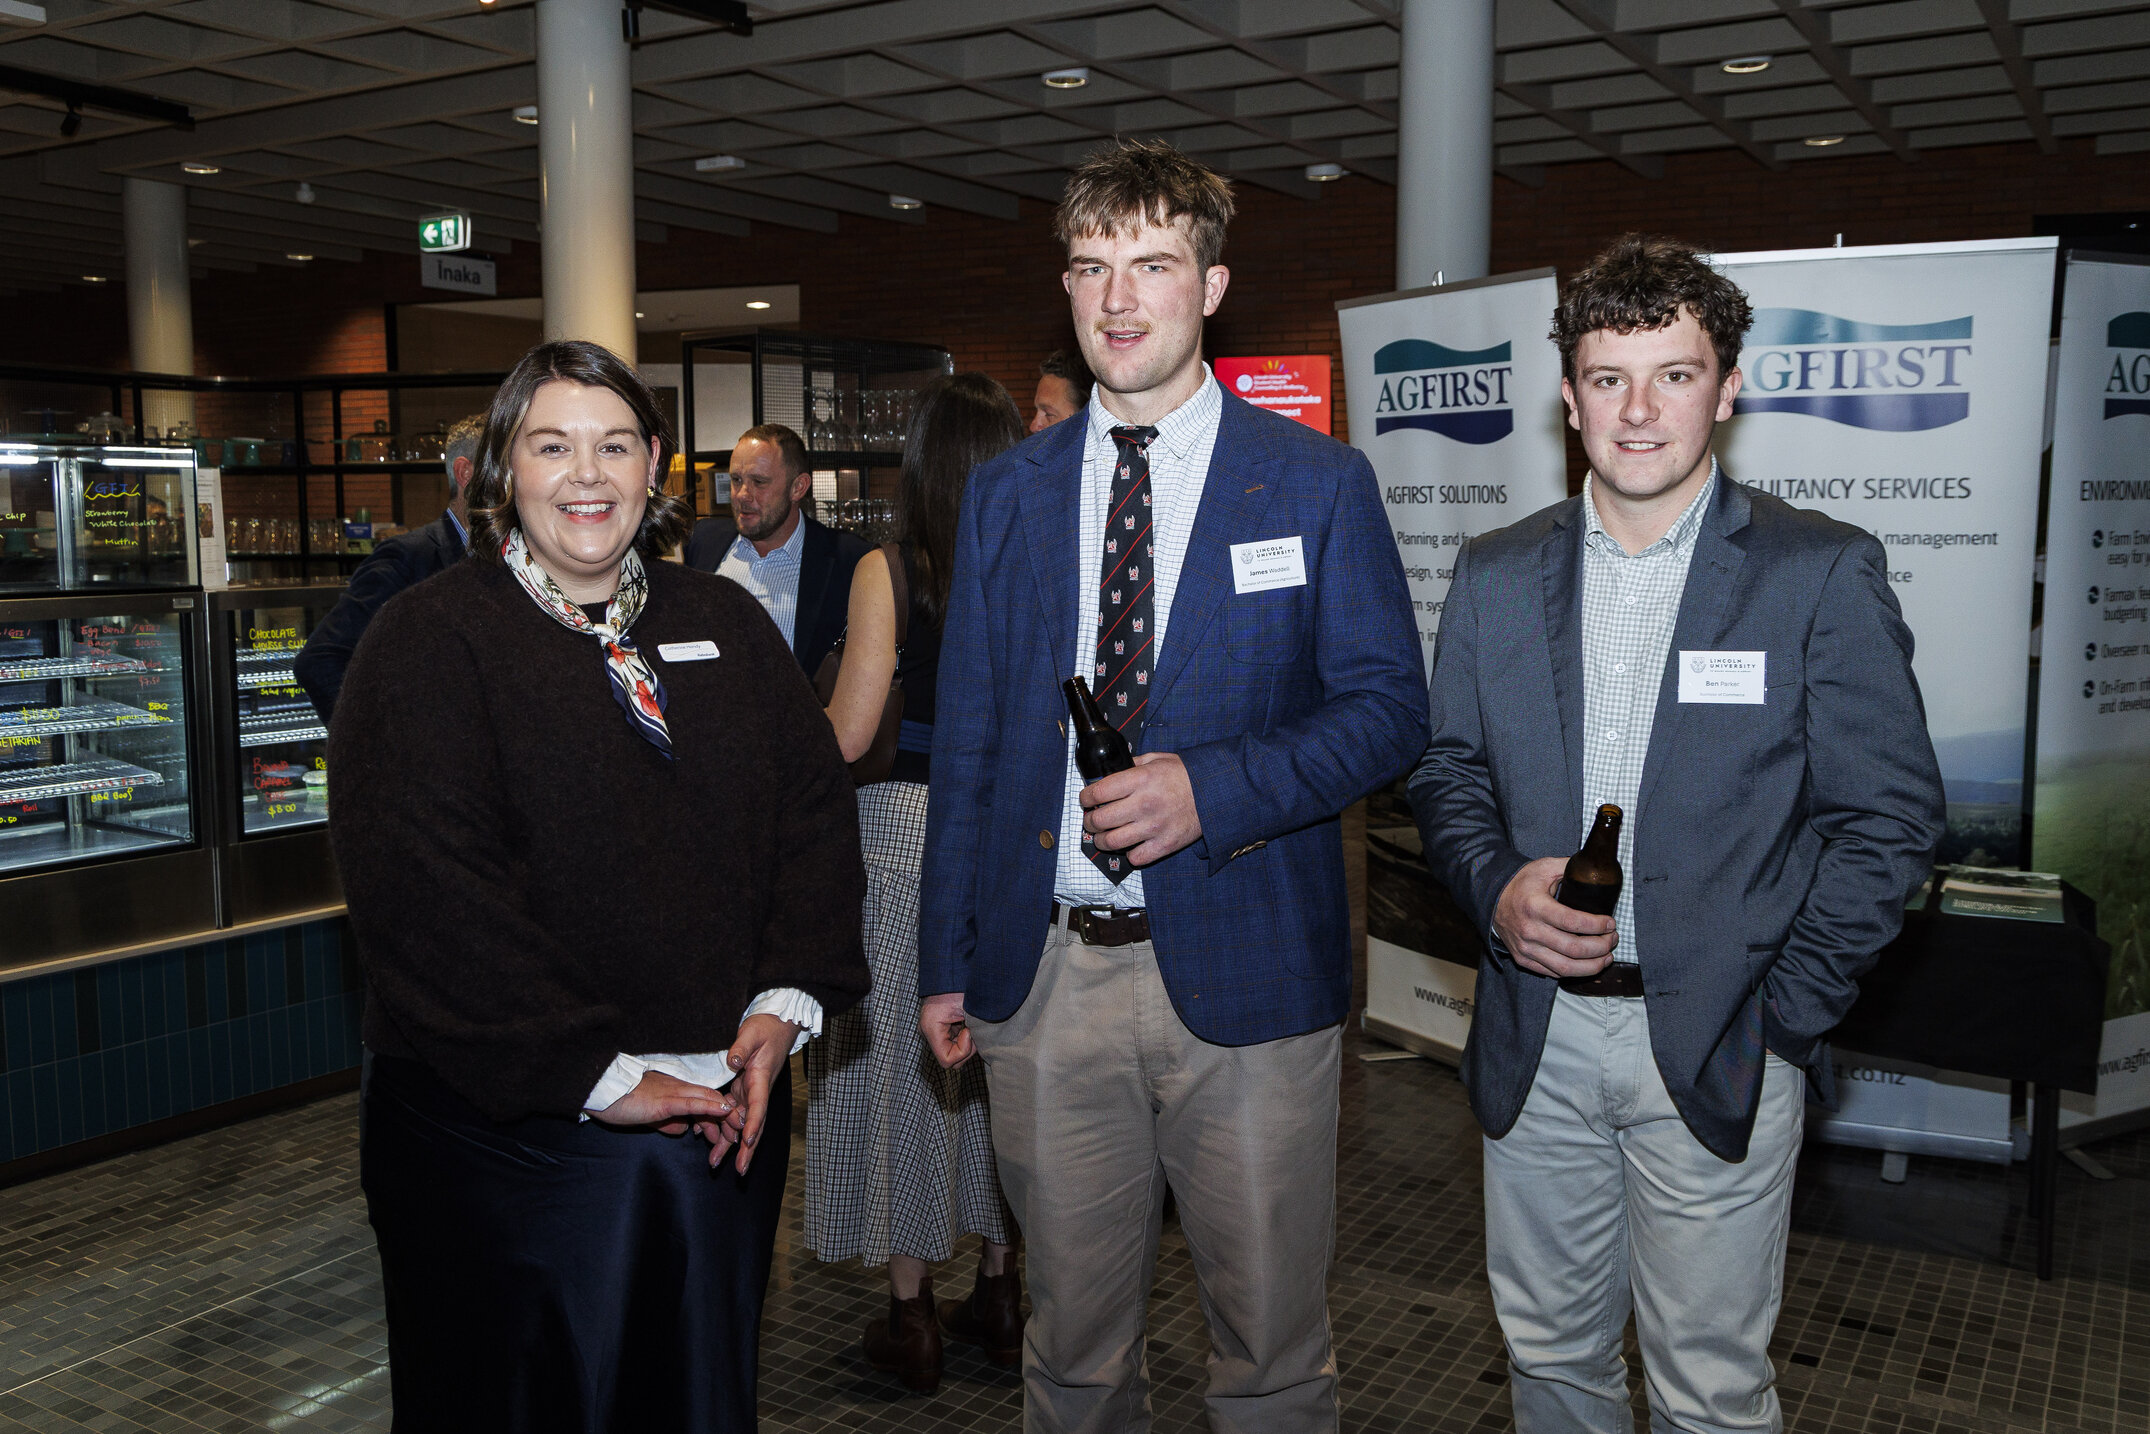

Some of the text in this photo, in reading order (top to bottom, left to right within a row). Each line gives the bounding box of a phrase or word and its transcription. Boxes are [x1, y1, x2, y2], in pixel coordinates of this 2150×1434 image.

[1741, 345, 1972, 392] GFIRST
[1375, 366, 1513, 413] AGFIRST
[1386, 484, 1508, 504] AGFIRST SOLUTIONS
[1738, 477, 1971, 499] ULTANCY SERVICES
[85, 509, 129, 518] Strawberry
[104, 538, 139, 546] Muffin
[1397, 531, 1439, 549] Planning
[1441, 531, 1460, 546] and
[1885, 530, 1998, 549] management
[1256, 549, 1295, 558] UNIVERSITY
[1250, 569, 1268, 577] James
[81, 625, 98, 640] Egg
[249, 627, 297, 640] CHOCOLATE
[252, 641, 284, 652] MOUSSE
[148, 702, 168, 711] BBQ
[91, 792, 109, 803] BBQ
[1832, 1063, 1906, 1086] t.co.nz
